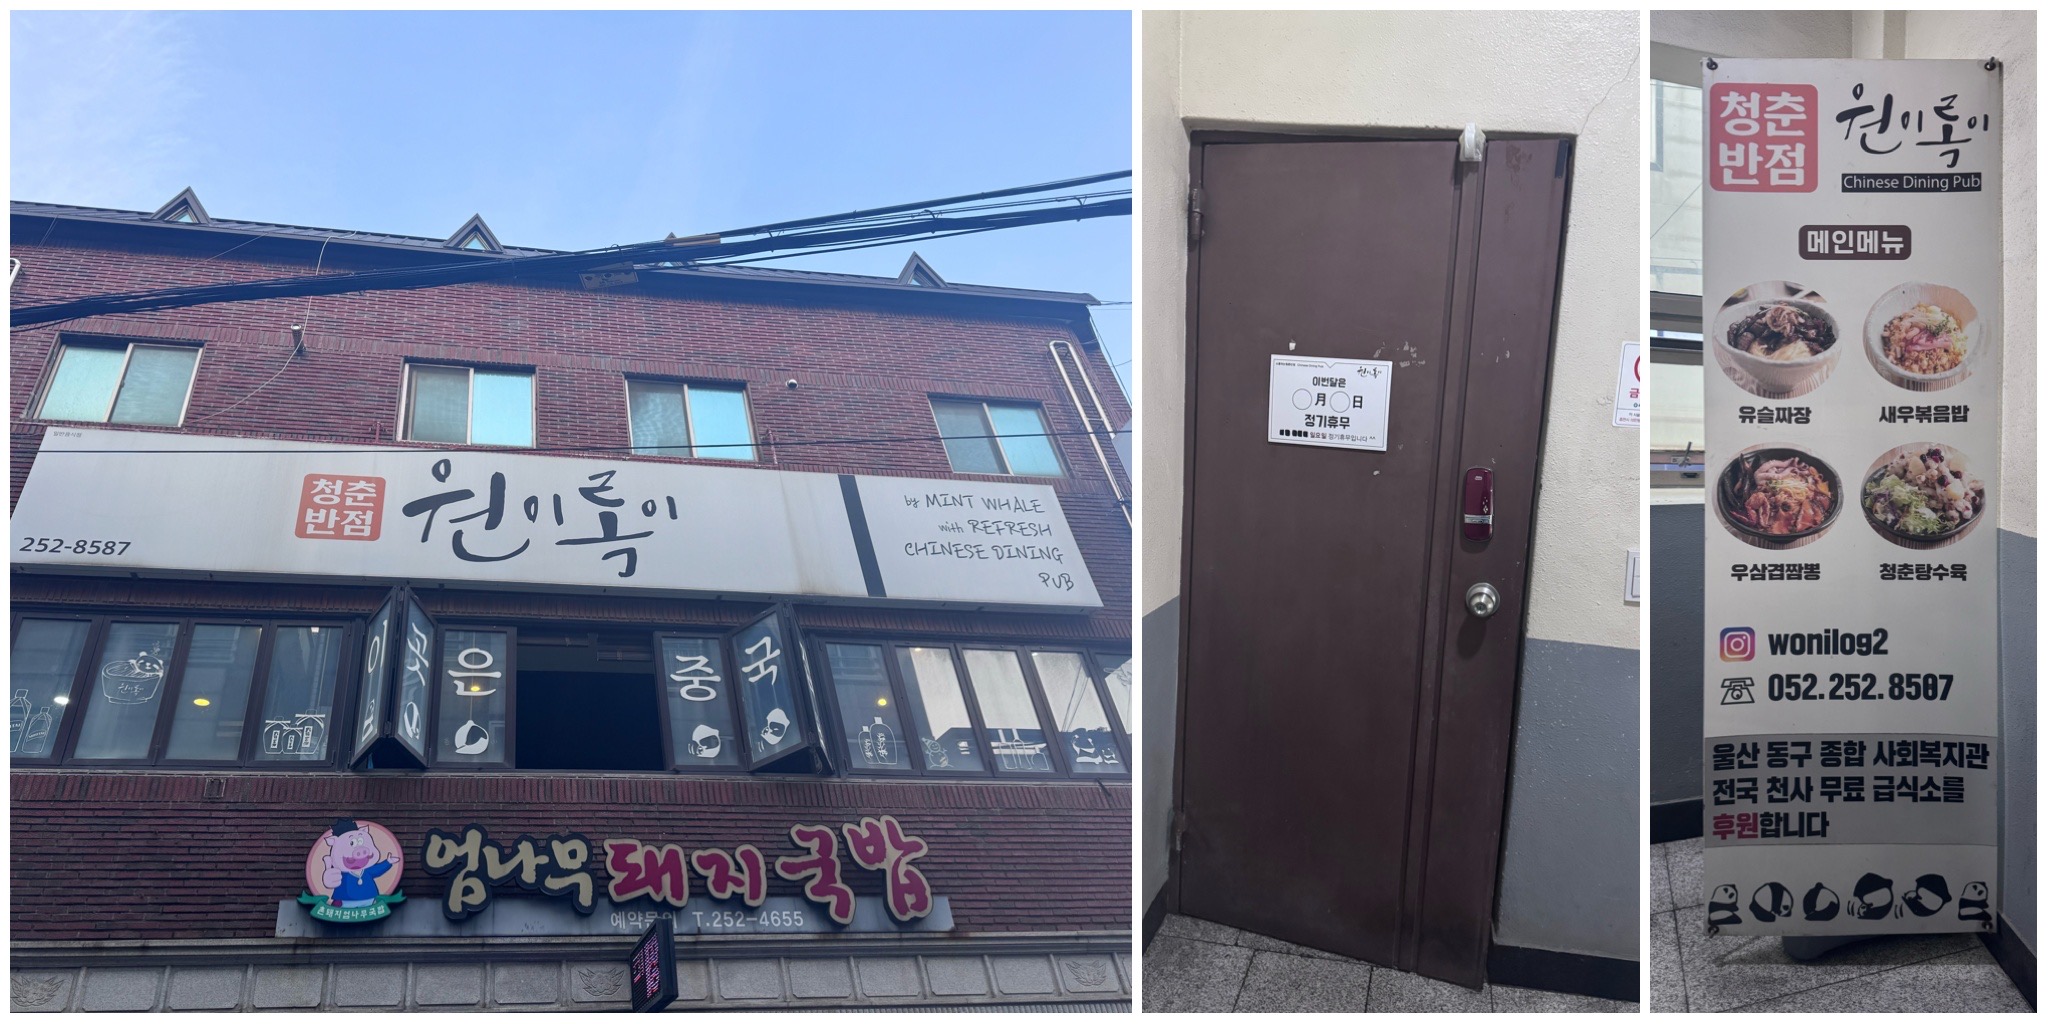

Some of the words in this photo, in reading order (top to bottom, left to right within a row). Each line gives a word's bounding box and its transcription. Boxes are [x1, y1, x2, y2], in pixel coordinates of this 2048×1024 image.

[1720, 91, 1807, 137] 청춘
[1718, 142, 1806, 187] 반점
[1843, 174, 1899, 190] Chinese
[1903, 174, 1949, 192] Dining
[1953, 174, 1982, 190] Pub
[1806, 229, 1905, 256] 메인메뉴
[1312, 376, 1347, 388] 이번달은
[1315, 392, 1326, 407] 月
[1352, 395, 1363, 409] 日
[1304, 414, 1351, 429] 정기휴무
[1738, 405, 1812, 425] 유슬짜장
[1879, 404, 1970, 424] 새우볶음밥
[310, 477, 377, 507] 청춘
[904, 495, 919, 509] by
[925, 493, 973, 510] MINT
[981, 497, 1045, 514] WHALE
[304, 508, 375, 537] 반점
[938, 521, 964, 534] with
[967, 517, 1052, 537] REFRESH
[19, 537, 131, 557] 252-8587
[904, 540, 989, 560] CHINESE
[991, 543, 1064, 564] DINING
[1039, 572, 1076, 592] PUB
[1730, 562, 1821, 582] 우삼겹짬뽕
[1879, 562, 1968, 582] 청춘탕수육
[1768, 627, 1889, 656] wonilog2
[1712, 741, 1760, 770] 울산
[1766, 741, 1812, 769] 동구
[1820, 740, 1866, 768] 종합
[1873, 739, 1990, 770] 사회복지관
[1712, 777, 1759, 806] 전국
[1766, 776, 1813, 804] 천사
[1820, 776, 1865, 803] 무료
[1873, 775, 1965, 804] 급식소를
[1712, 810, 1830, 841] 후원합니다
